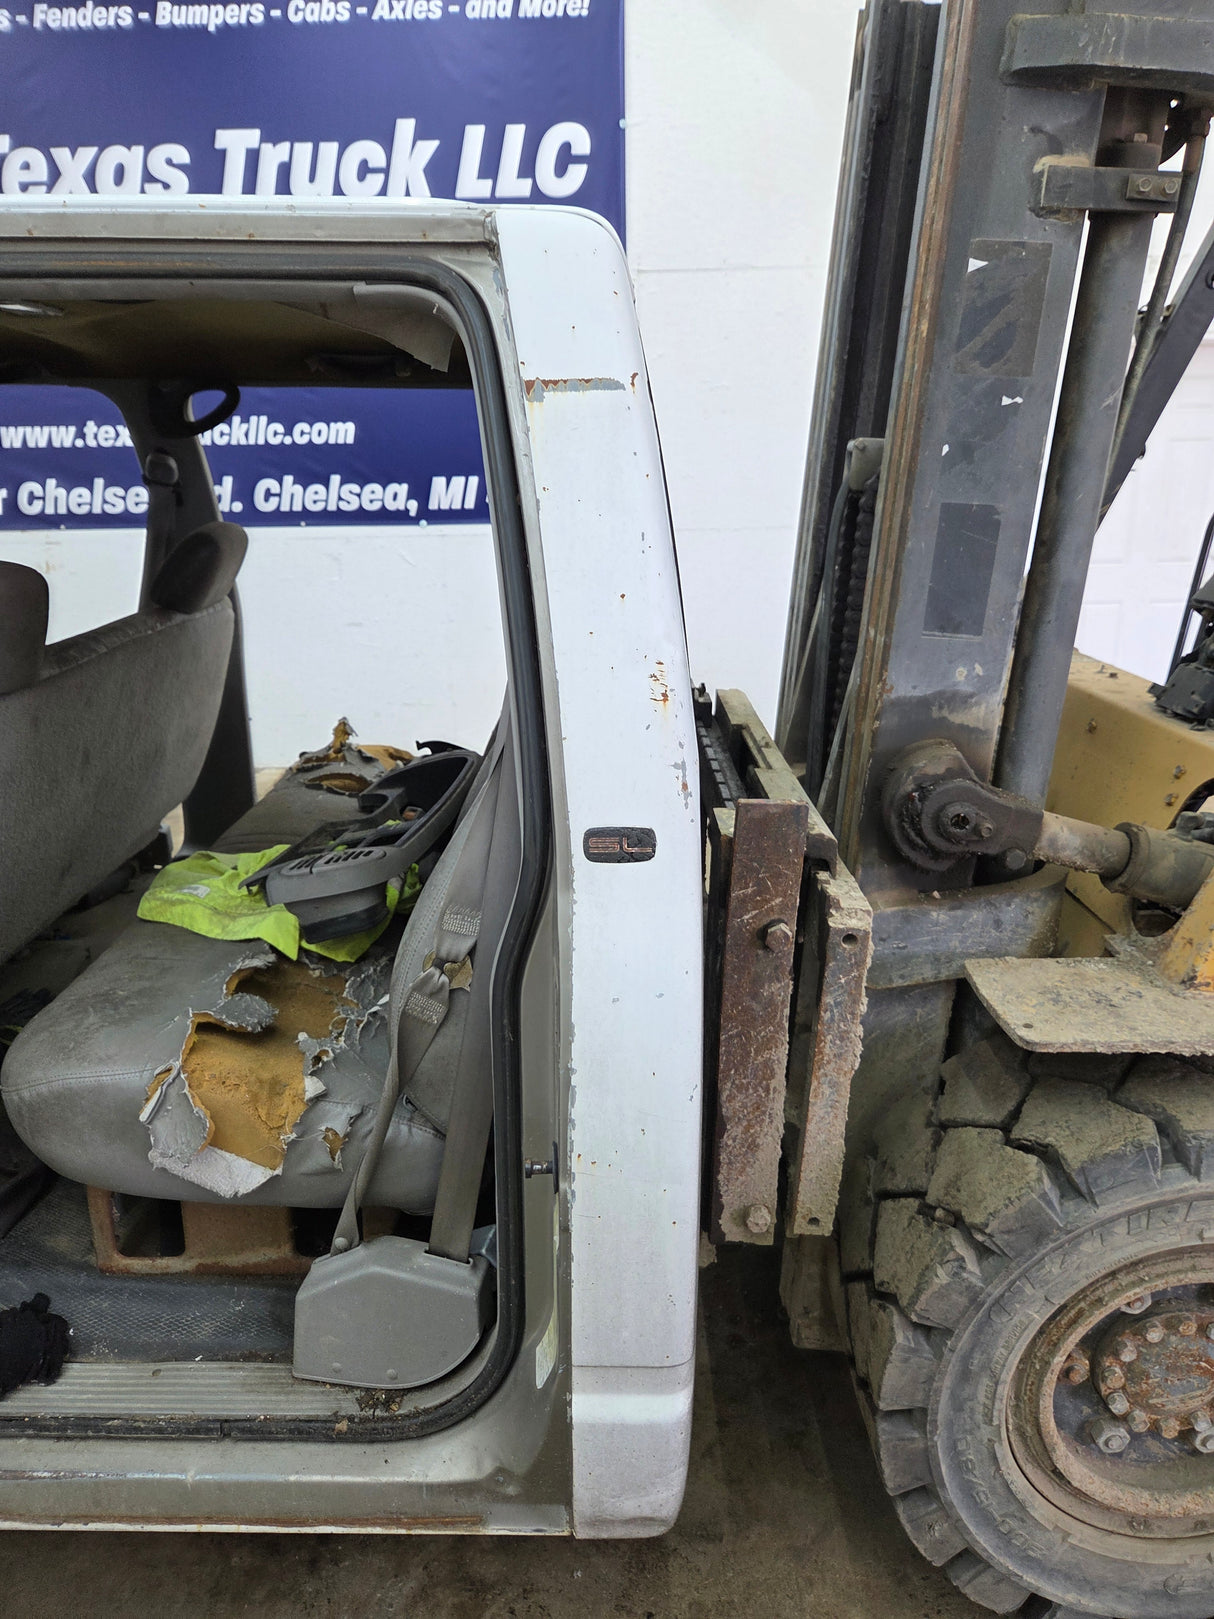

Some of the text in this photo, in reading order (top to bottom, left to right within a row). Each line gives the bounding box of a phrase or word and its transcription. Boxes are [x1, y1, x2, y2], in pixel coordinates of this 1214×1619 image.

[33, 1, 133, 29] Fenders
[155, 1, 265, 32] Bumpers
[287, 0, 350, 22] Cabs
[371, 0, 442, 20] Axles
[465, 0, 512, 19] and
[518, 0, 591, 18] More!
[0, 118, 592, 199] exas Truck LLC
[17, 477, 149, 516] Chelse
[253, 474, 418, 517] Chelsea,
[428, 475, 479, 510] MI
[588, 837, 653, 853] SL
